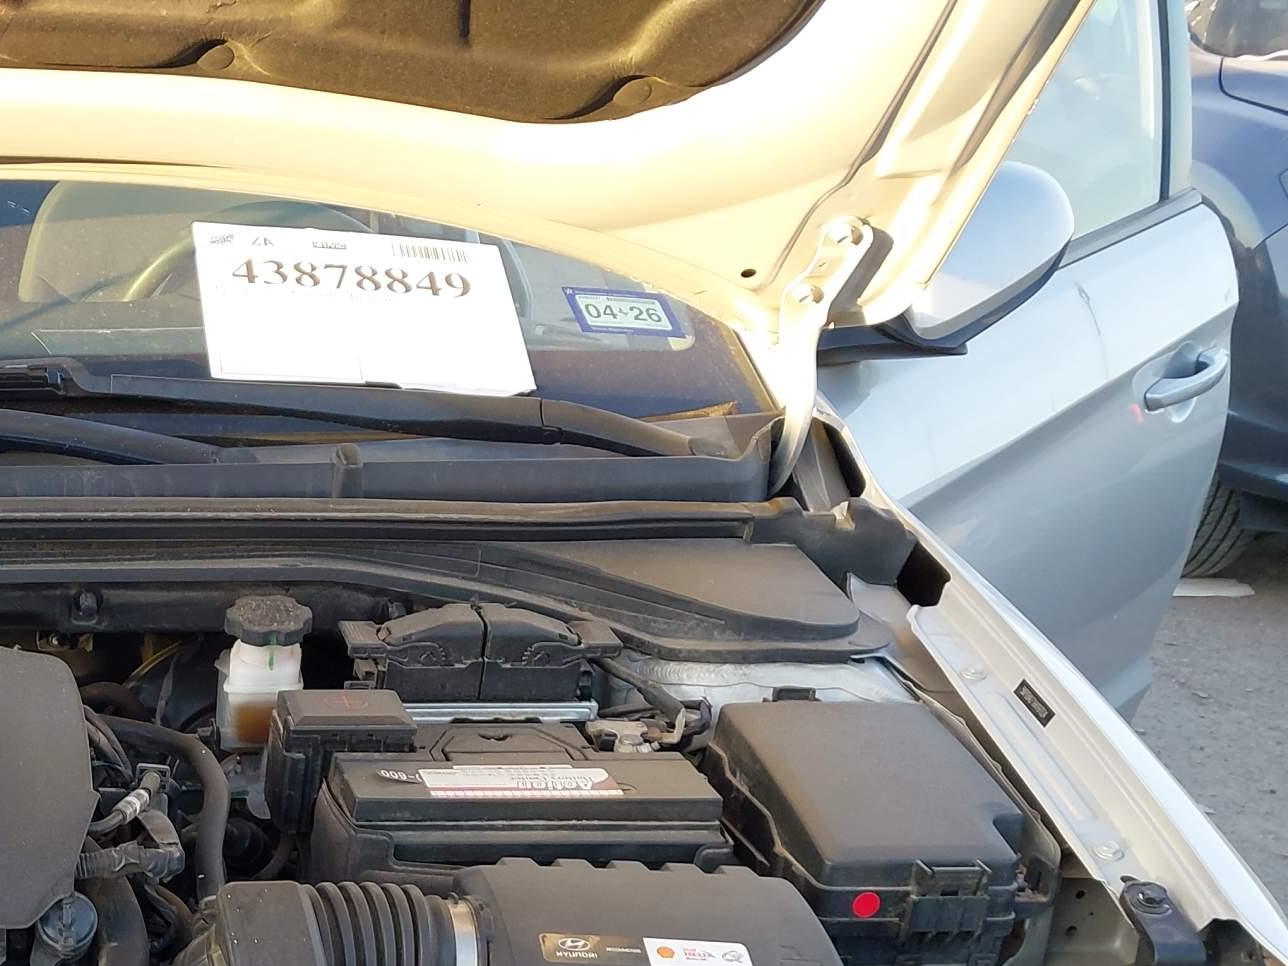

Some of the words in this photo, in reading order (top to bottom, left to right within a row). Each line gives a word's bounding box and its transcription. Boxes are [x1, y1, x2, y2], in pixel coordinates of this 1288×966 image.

[231, 257, 472, 299] 43878849
[584, 303, 619, 320] 04
[629, 305, 663, 323] 26
[555, 951, 598, 959] HYUNDAI
